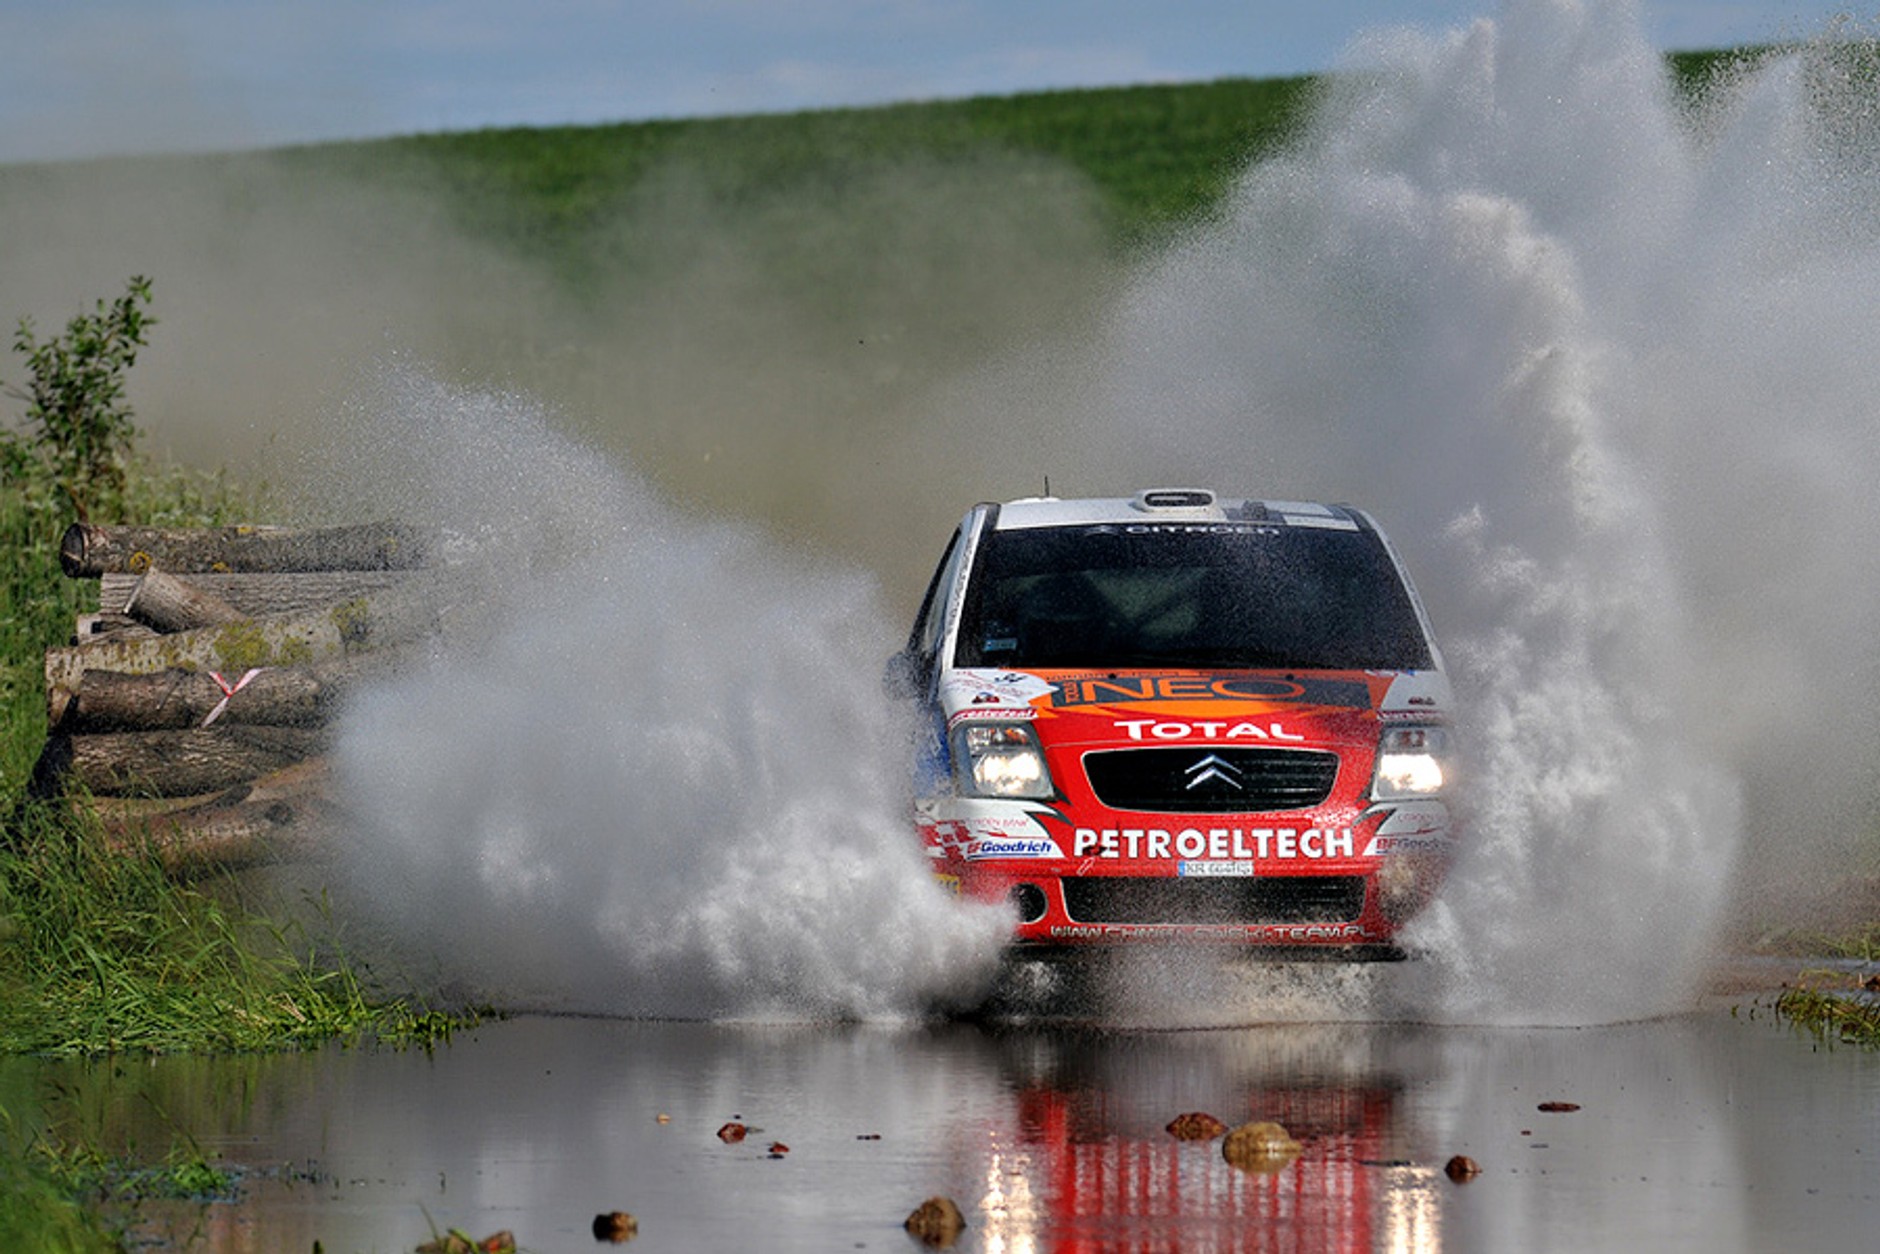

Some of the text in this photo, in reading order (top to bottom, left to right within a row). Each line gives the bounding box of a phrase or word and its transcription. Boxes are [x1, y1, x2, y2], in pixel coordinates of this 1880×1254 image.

[1082, 677, 1305, 703] NEO
[1113, 719, 1305, 741] TOTAL
[966, 839, 1053, 854] BFGoodrich
[1073, 827, 1354, 860] PETROELTECH
